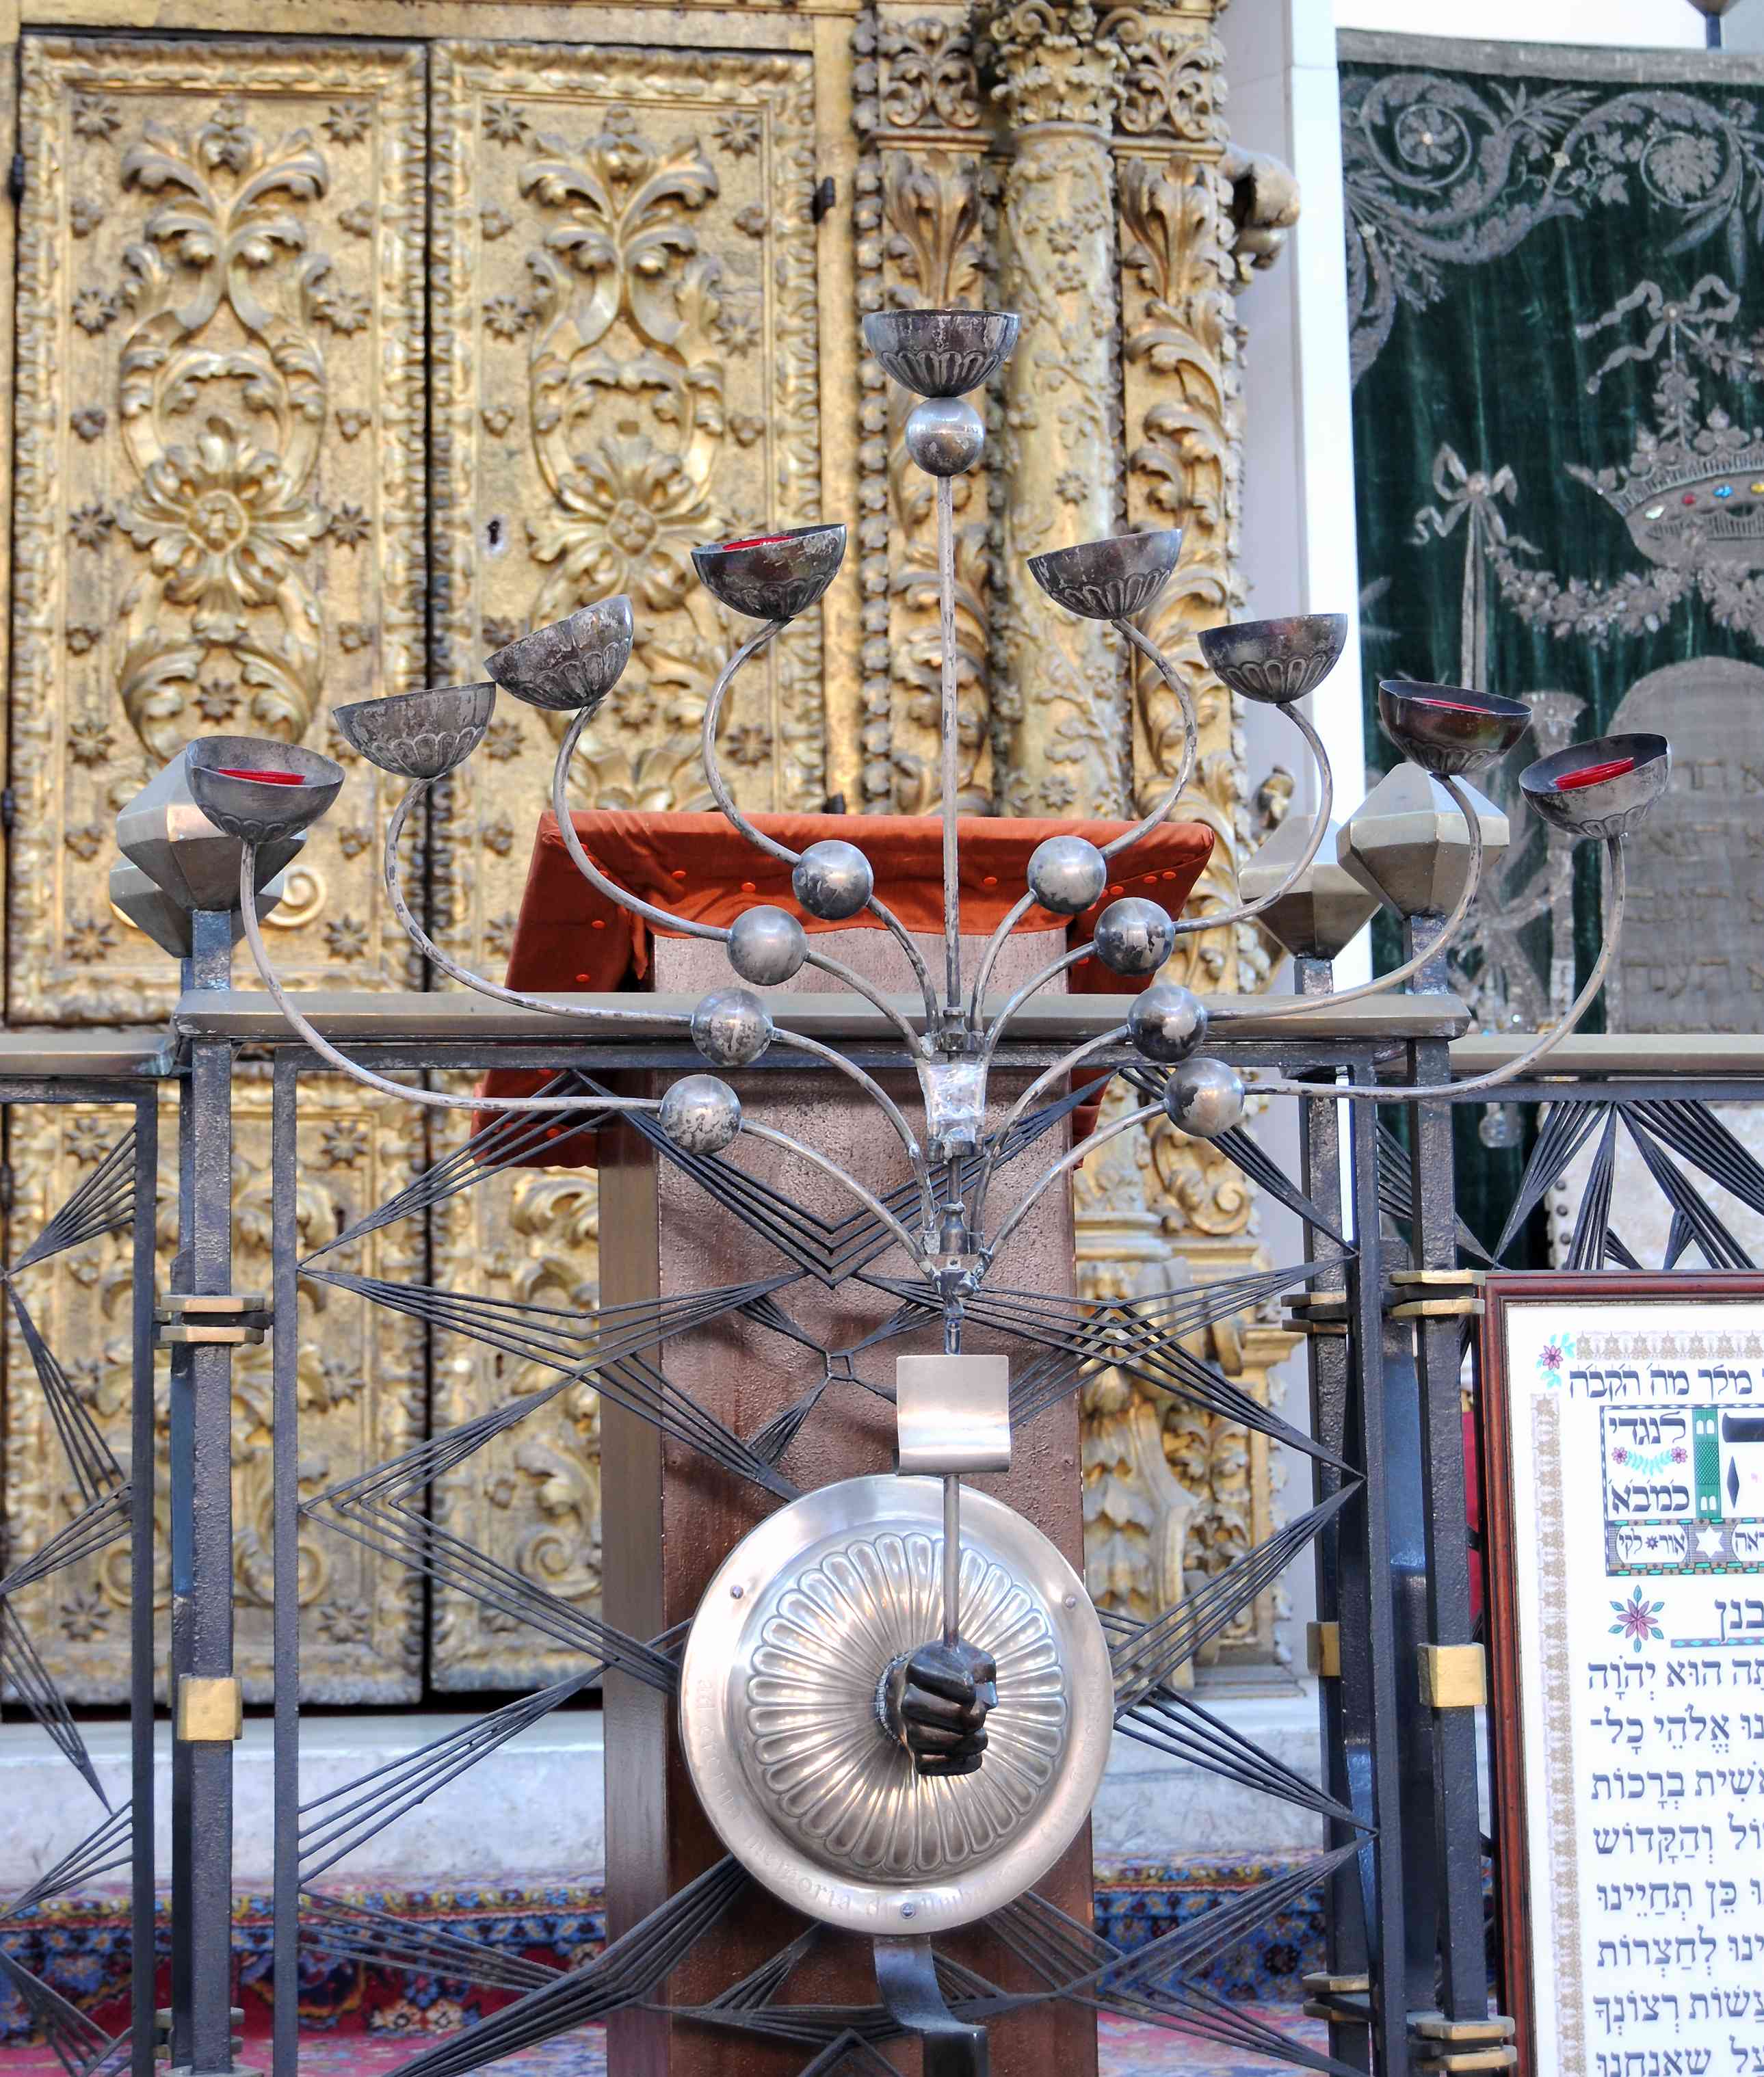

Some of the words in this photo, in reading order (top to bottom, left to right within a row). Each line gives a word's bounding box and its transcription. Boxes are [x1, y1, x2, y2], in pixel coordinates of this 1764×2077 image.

[1698, 1364, 1752, 1401] מלך
[1609, 1411, 1685, 1445] לנגדי
[1659, 1534, 1685, 1555] אור
[1666, 1659, 1721, 1687] הוּא
